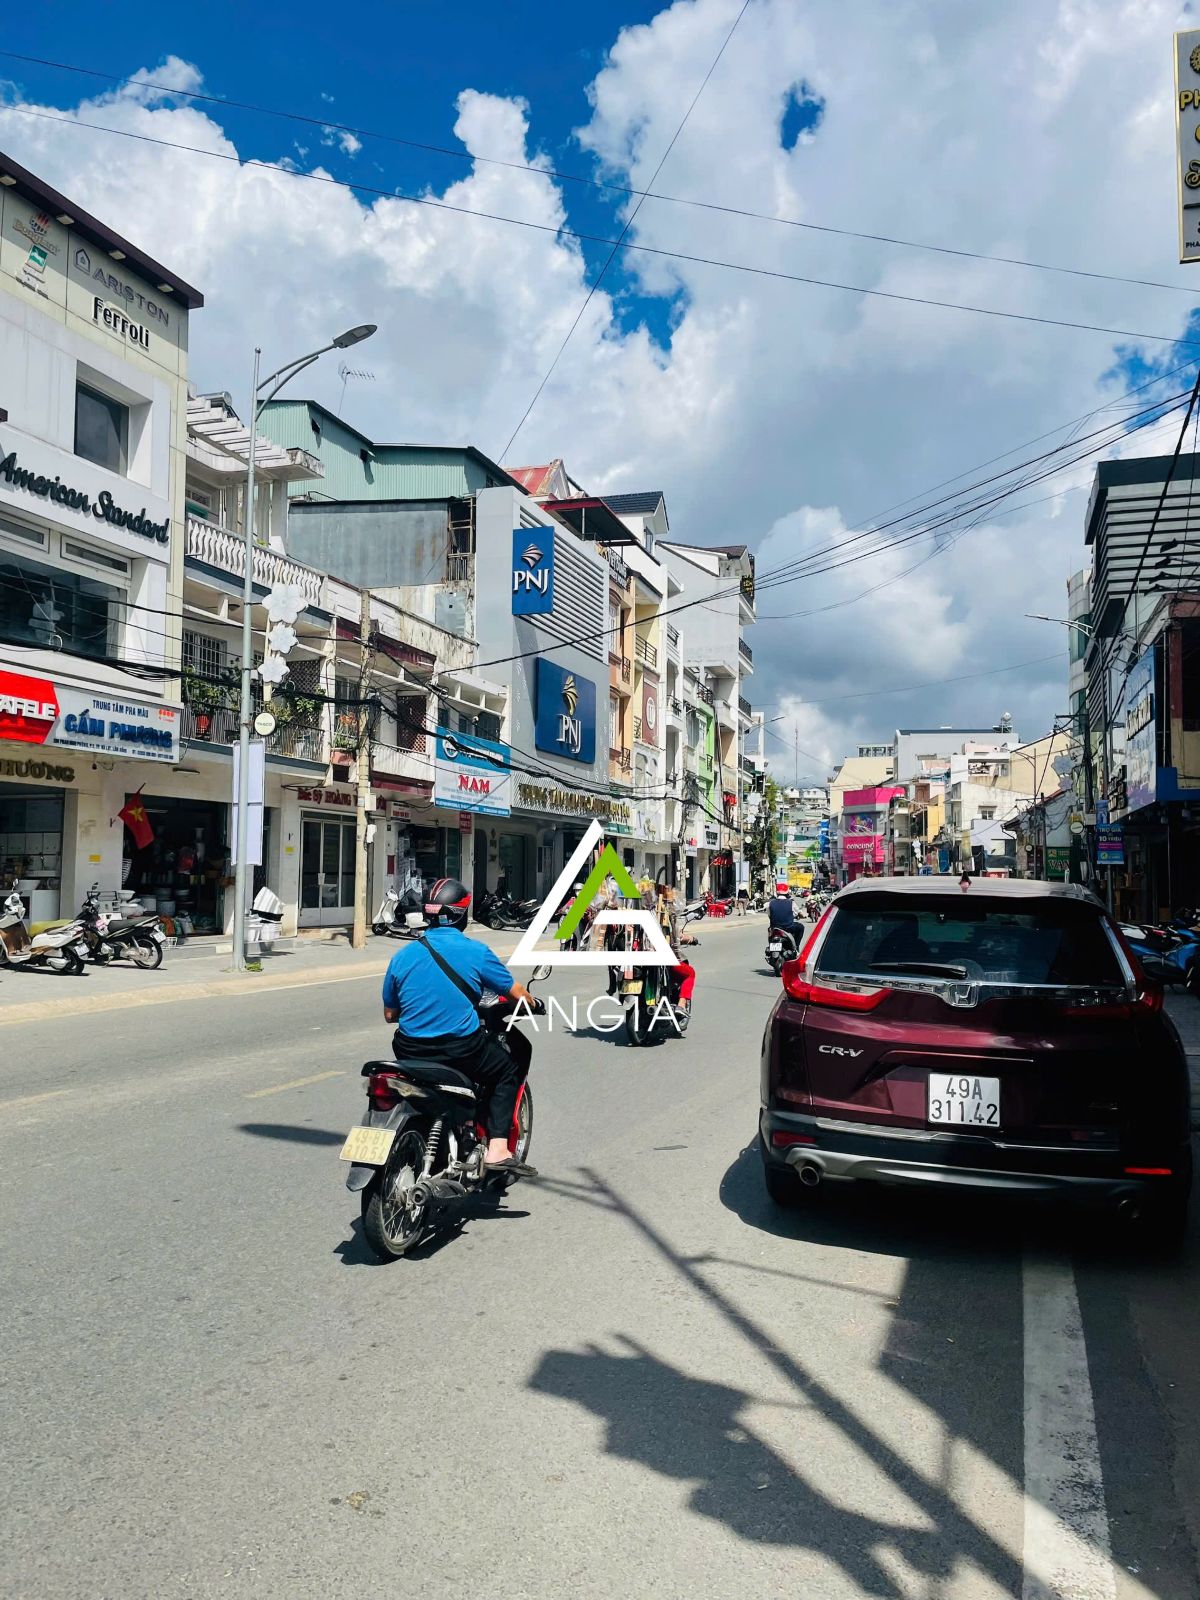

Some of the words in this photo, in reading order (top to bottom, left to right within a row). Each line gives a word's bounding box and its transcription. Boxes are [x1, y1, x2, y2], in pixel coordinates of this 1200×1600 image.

[93, 267, 169, 327] ARISTON
[93, 297, 149, 348] Ferroli
[0, 452, 91, 513] American
[92, 490, 170, 543] Standard
[513, 569, 550, 594] PNJ
[93, 700, 111, 711] TRUNG
[125, 706, 136, 716] PHA
[557, 713, 582, 754] PNJ
[458, 775, 490, 794] NAM
[818, 1045, 864, 1058] CR-V
[946, 1078, 983, 1101] 49A
[931, 1099, 998, 1125] 311.42
